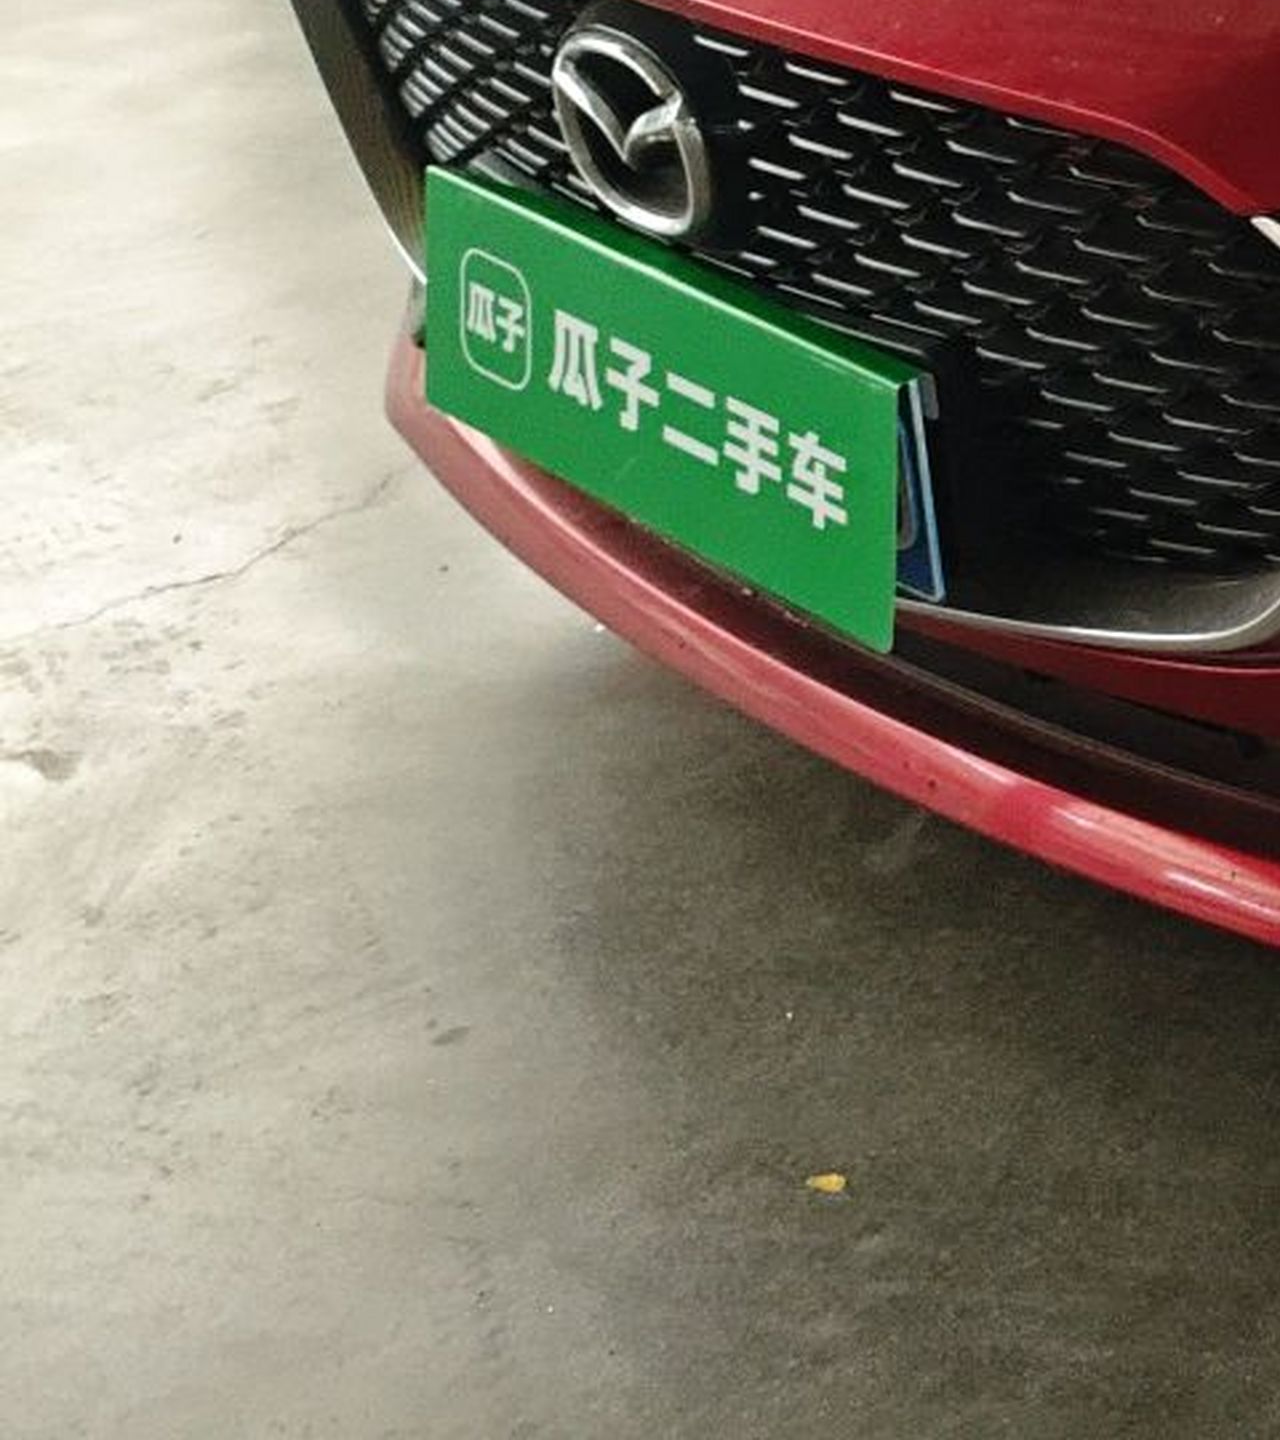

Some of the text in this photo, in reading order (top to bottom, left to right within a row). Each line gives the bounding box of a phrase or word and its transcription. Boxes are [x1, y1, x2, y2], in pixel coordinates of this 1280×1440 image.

[467, 281, 526, 353] 瓜子
[547, 308, 850, 530] 瓜子二手车
